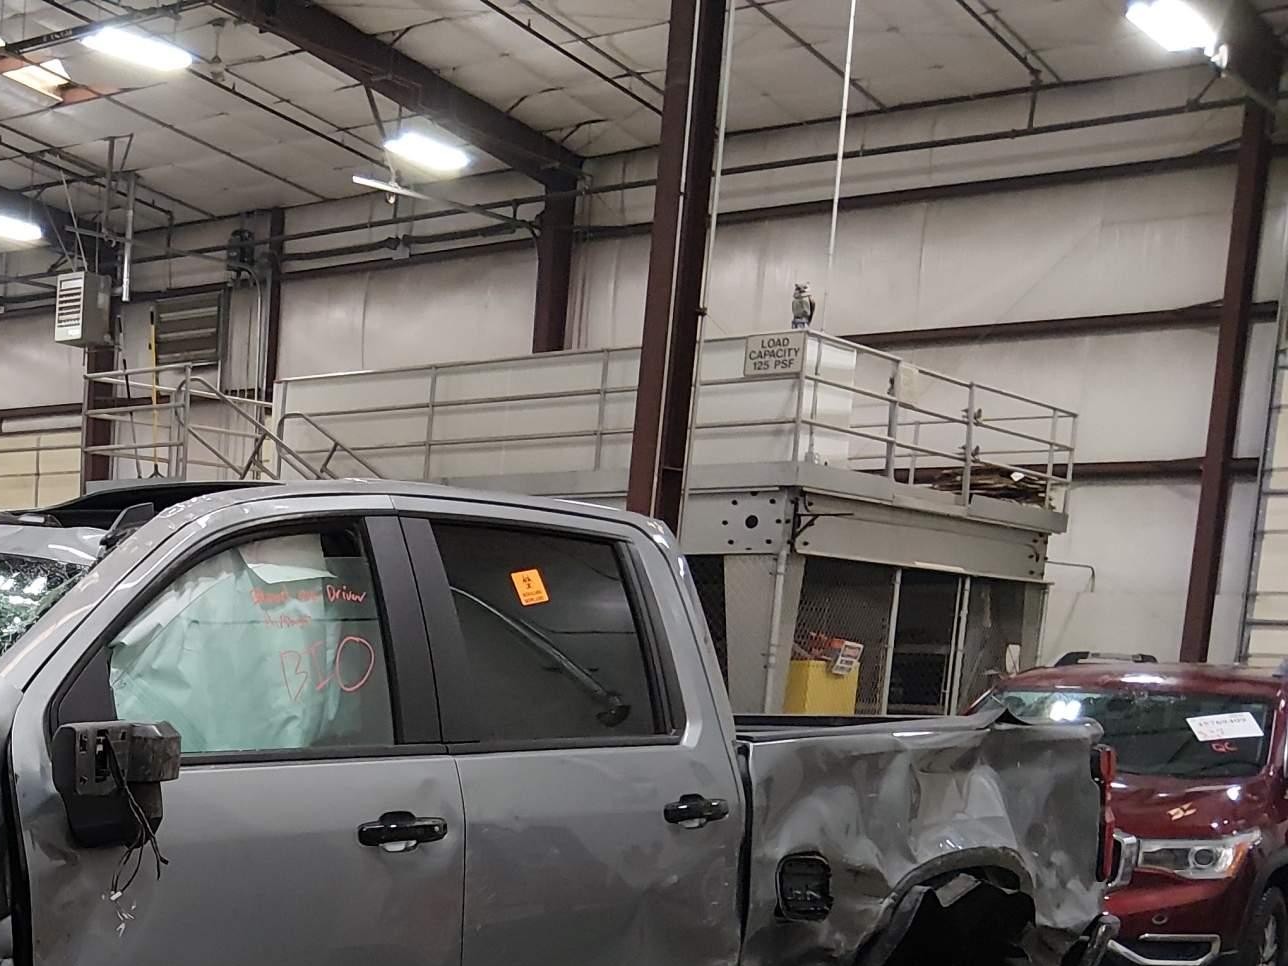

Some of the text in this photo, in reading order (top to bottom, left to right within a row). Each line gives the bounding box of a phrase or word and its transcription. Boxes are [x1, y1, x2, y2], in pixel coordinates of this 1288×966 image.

[761, 337, 790, 348] LOAD
[749, 347, 800, 360] CAPACITY
[753, 358, 794, 370] 125 PSF
